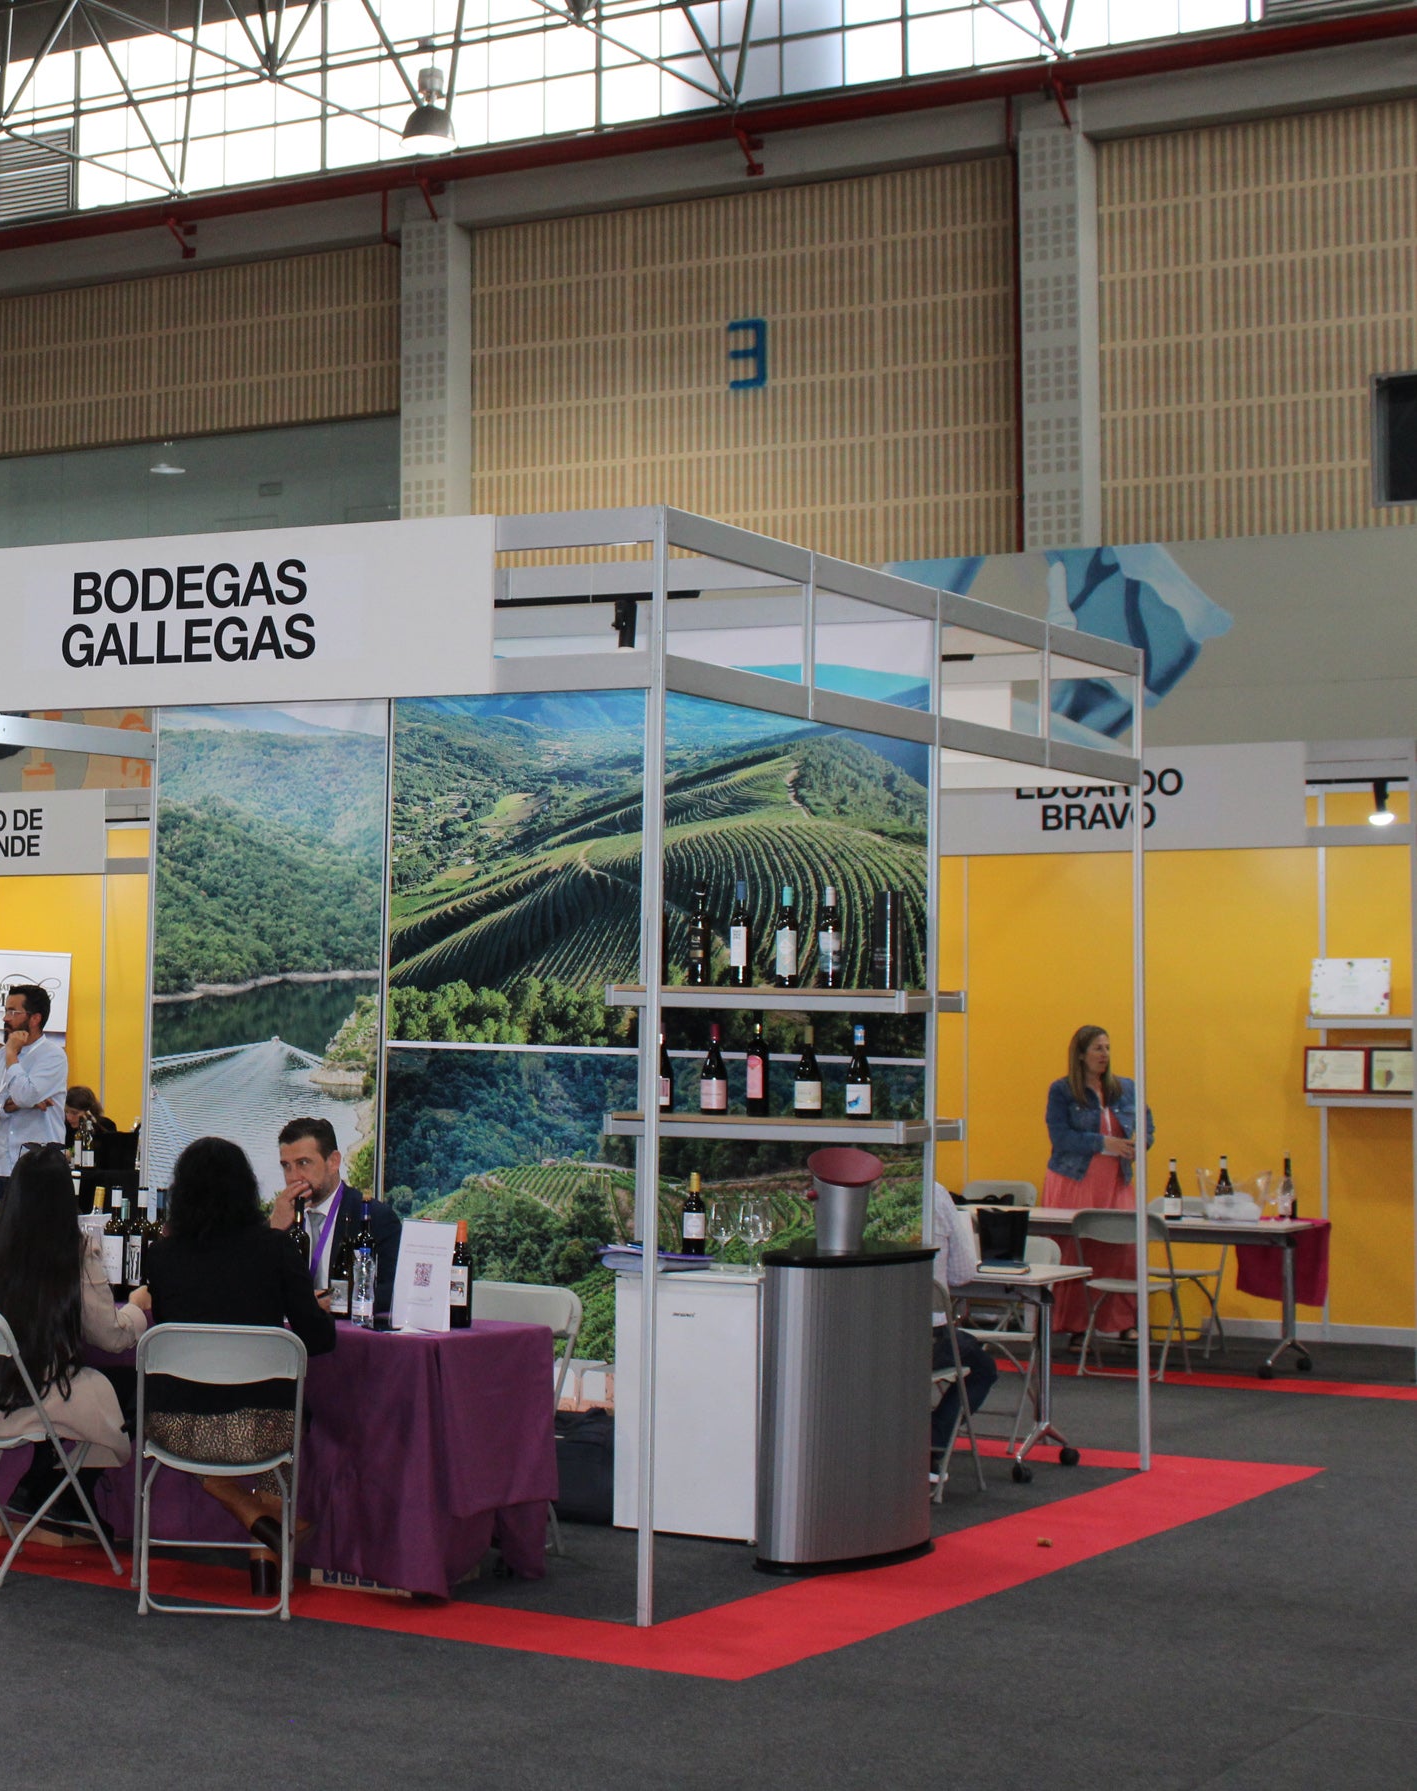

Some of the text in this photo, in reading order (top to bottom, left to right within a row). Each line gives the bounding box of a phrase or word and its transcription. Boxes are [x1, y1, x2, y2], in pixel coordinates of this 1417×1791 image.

[73, 558, 308, 615] BODEGAS
[61, 612, 316, 669] GALLEGAS
[12, 807, 44, 832] DE
[1041, 801, 1157, 831] BRAVO
